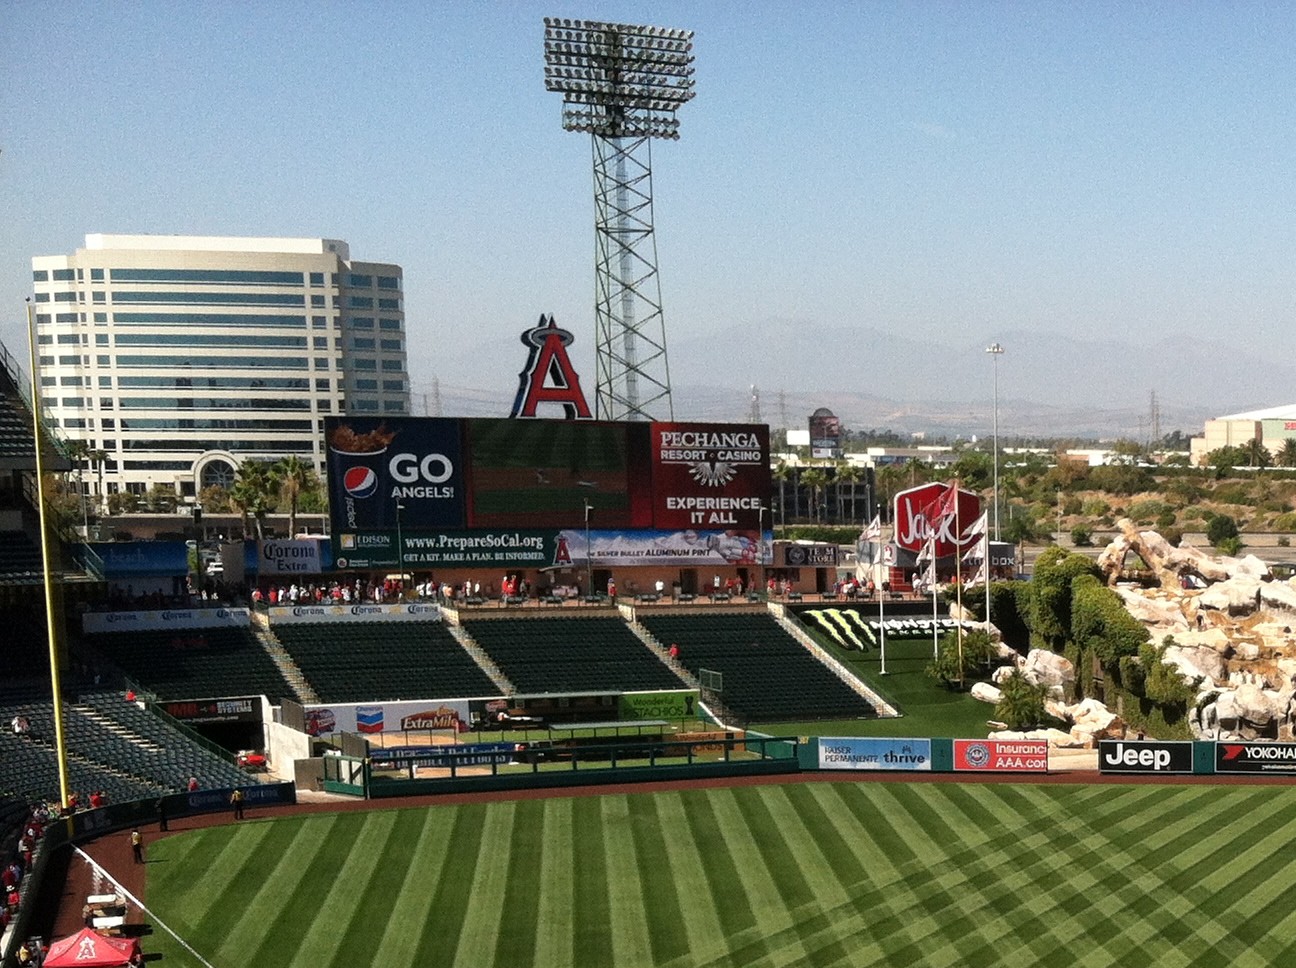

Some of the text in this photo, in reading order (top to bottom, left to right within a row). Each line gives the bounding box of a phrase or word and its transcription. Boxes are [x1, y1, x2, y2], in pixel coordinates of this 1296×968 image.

[660, 431, 760, 447] PECHANGA
[661, 450, 761, 461] RESORT CASINO
[389, 453, 453, 483] GO
[391, 487, 454, 498] ANGELS!
[666, 497, 760, 510] EXPERIENCE
[345, 497, 358, 529] pepsi
[691, 512, 738, 524] IT ALL
[357, 535, 390, 544] EDISON
[405, 533, 543, 550] www.PrepareSoCal.org
[264, 543, 315, 562] Corona
[403, 553, 419, 562] GET
[442, 553, 465, 562] MAKE
[691, 549, 710, 557] PINT
[277, 560, 308, 571] Extra
[992, 556, 1015, 566] box
[293, 606, 325, 616] Corona
[351, 605, 382, 615] Corona
[403, 717, 458, 730] ExtraMile
[824, 746, 851, 754] KAISER
[883, 750, 925, 763] thrive
[1106, 743, 1171, 770] Jeep
